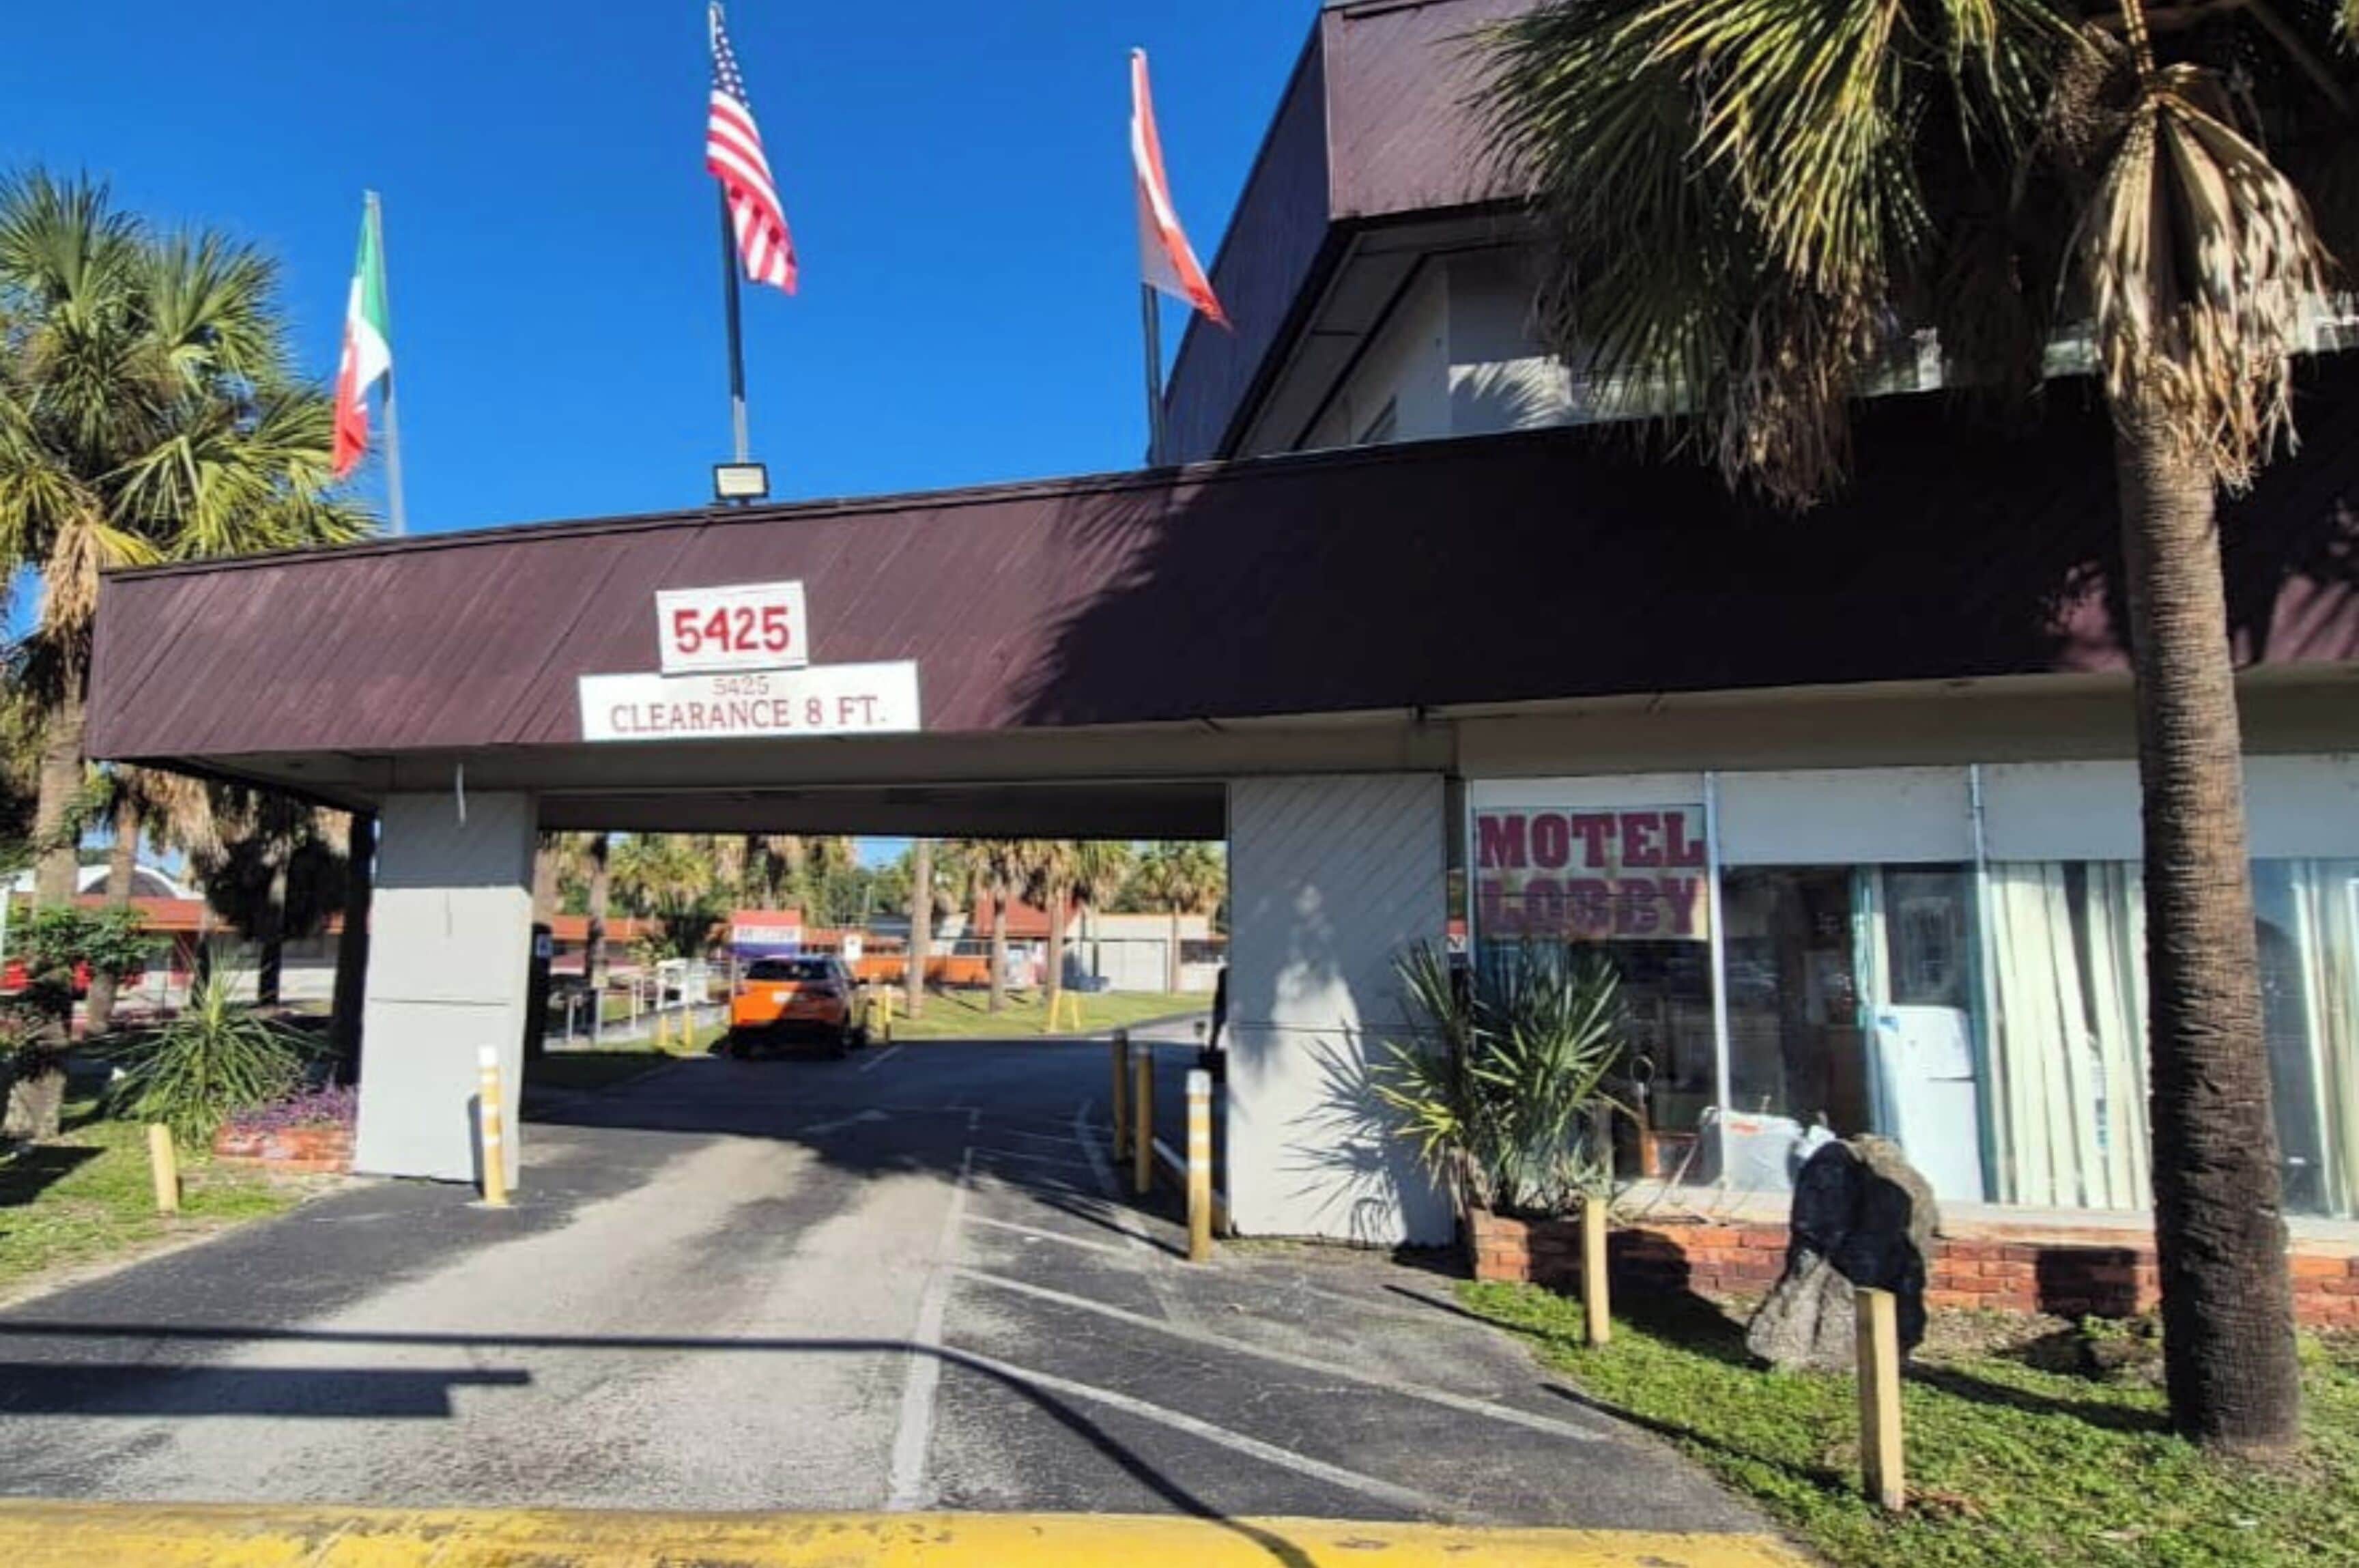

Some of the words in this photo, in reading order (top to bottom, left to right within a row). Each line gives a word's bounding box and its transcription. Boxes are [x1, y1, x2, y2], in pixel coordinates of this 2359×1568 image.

[673, 606, 790, 653] 5425
[713, 674, 769, 695] 5425
[610, 699, 790, 733] CLEARANCE
[805, 696, 823, 725] 8
[838, 695, 887, 726] FT.
[1477, 812, 1704, 868] MOTEL
[1480, 877, 1699, 936] LOBBY
